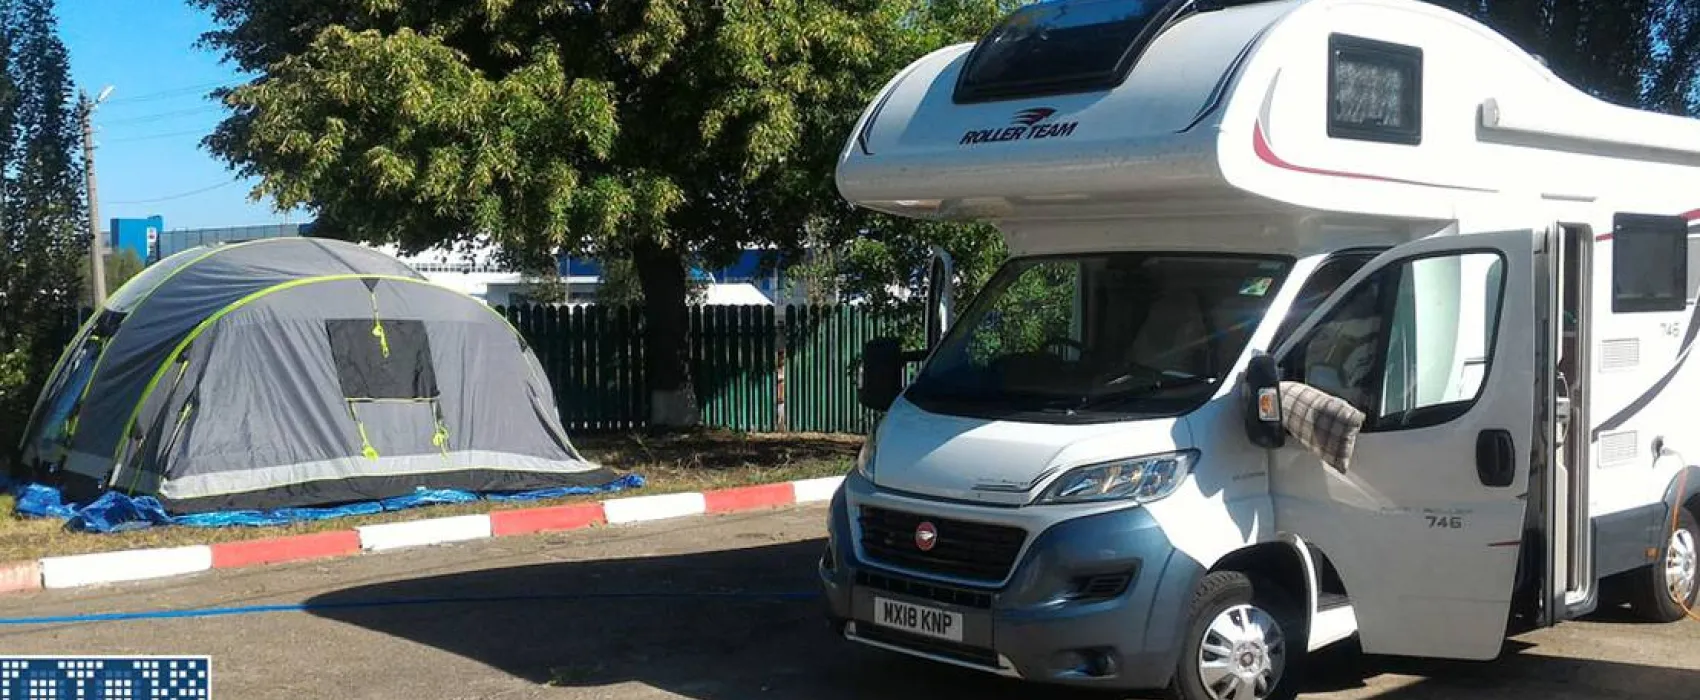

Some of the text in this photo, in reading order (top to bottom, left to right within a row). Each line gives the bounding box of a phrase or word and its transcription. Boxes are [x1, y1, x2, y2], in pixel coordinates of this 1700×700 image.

[960, 121, 1078, 145] ROLLER TEAM
[1424, 515, 1462, 529] 746
[921, 608, 952, 635] KNP
